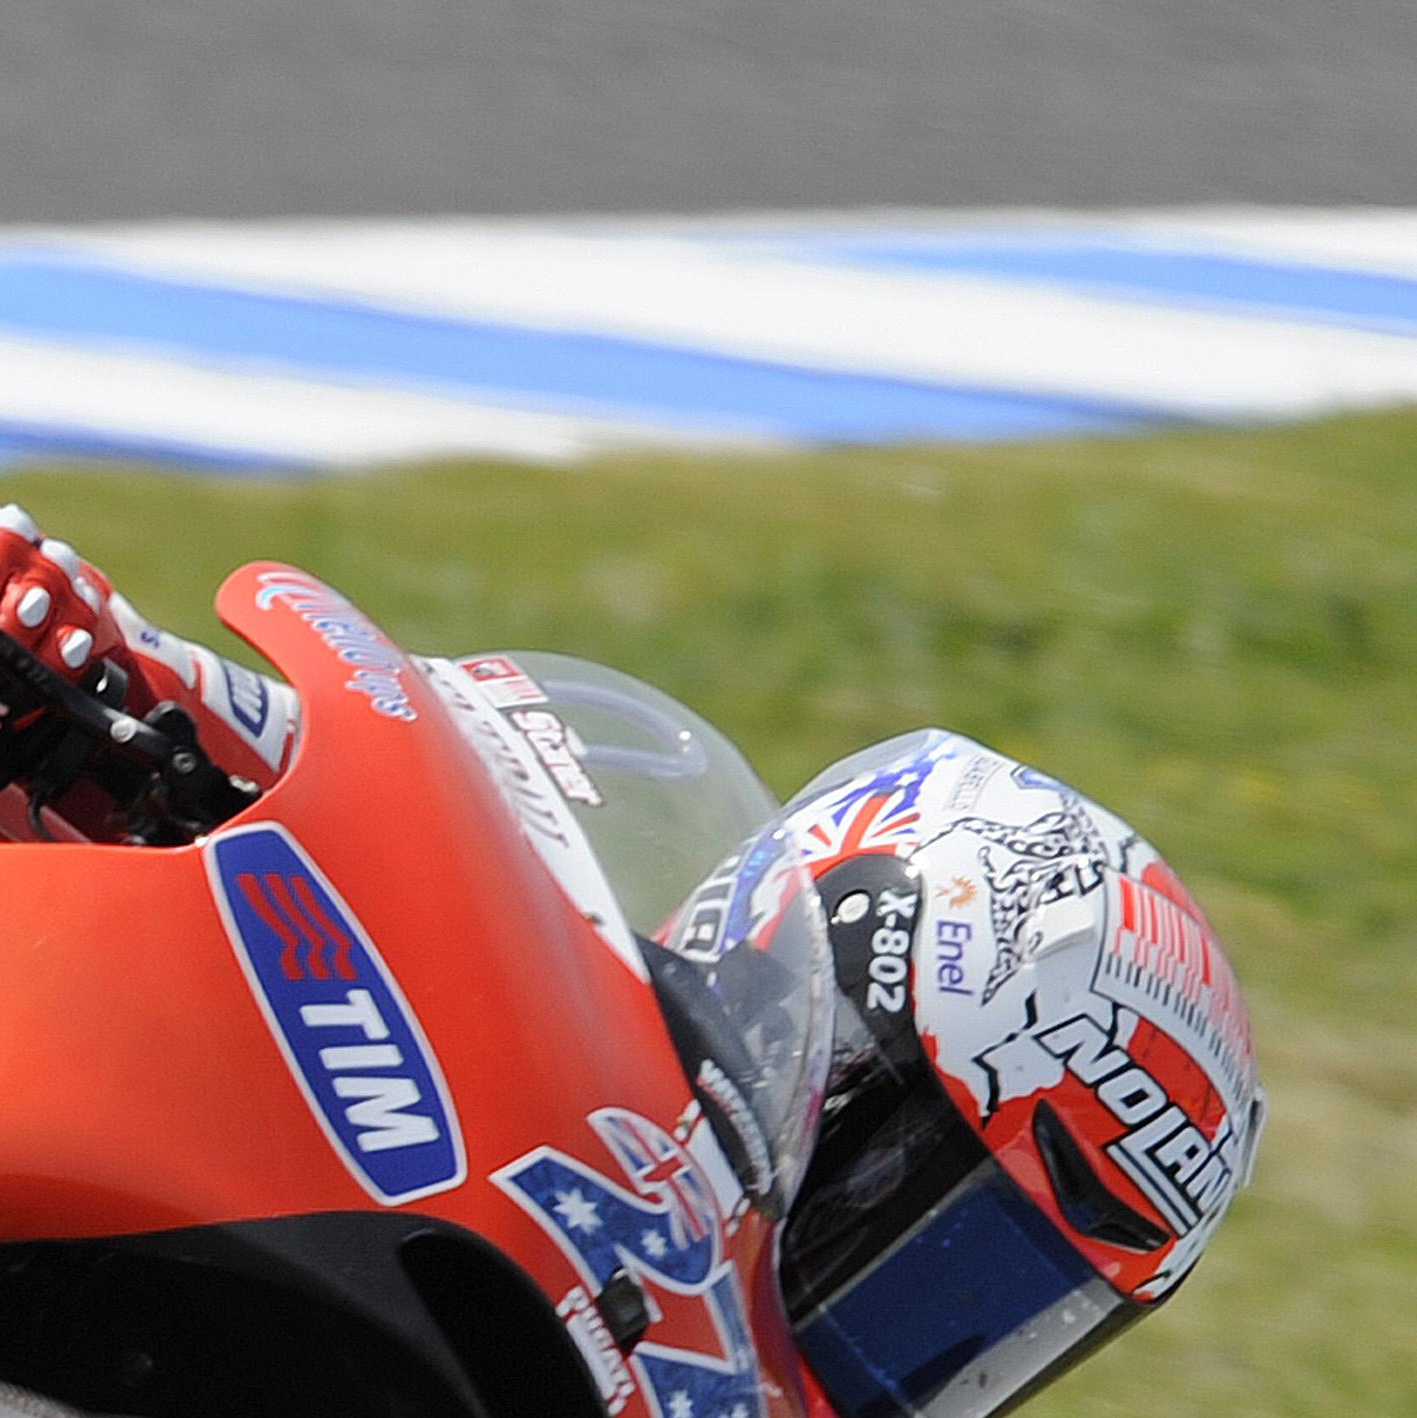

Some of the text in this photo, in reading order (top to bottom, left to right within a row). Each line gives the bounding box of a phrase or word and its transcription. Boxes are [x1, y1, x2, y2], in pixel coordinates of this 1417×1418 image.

[867, 888, 918, 1013] X-802
[935, 919, 974, 997] Enel
[299, 988, 439, 1152] TIM
[1031, 1012, 1233, 1232] NOLAN
